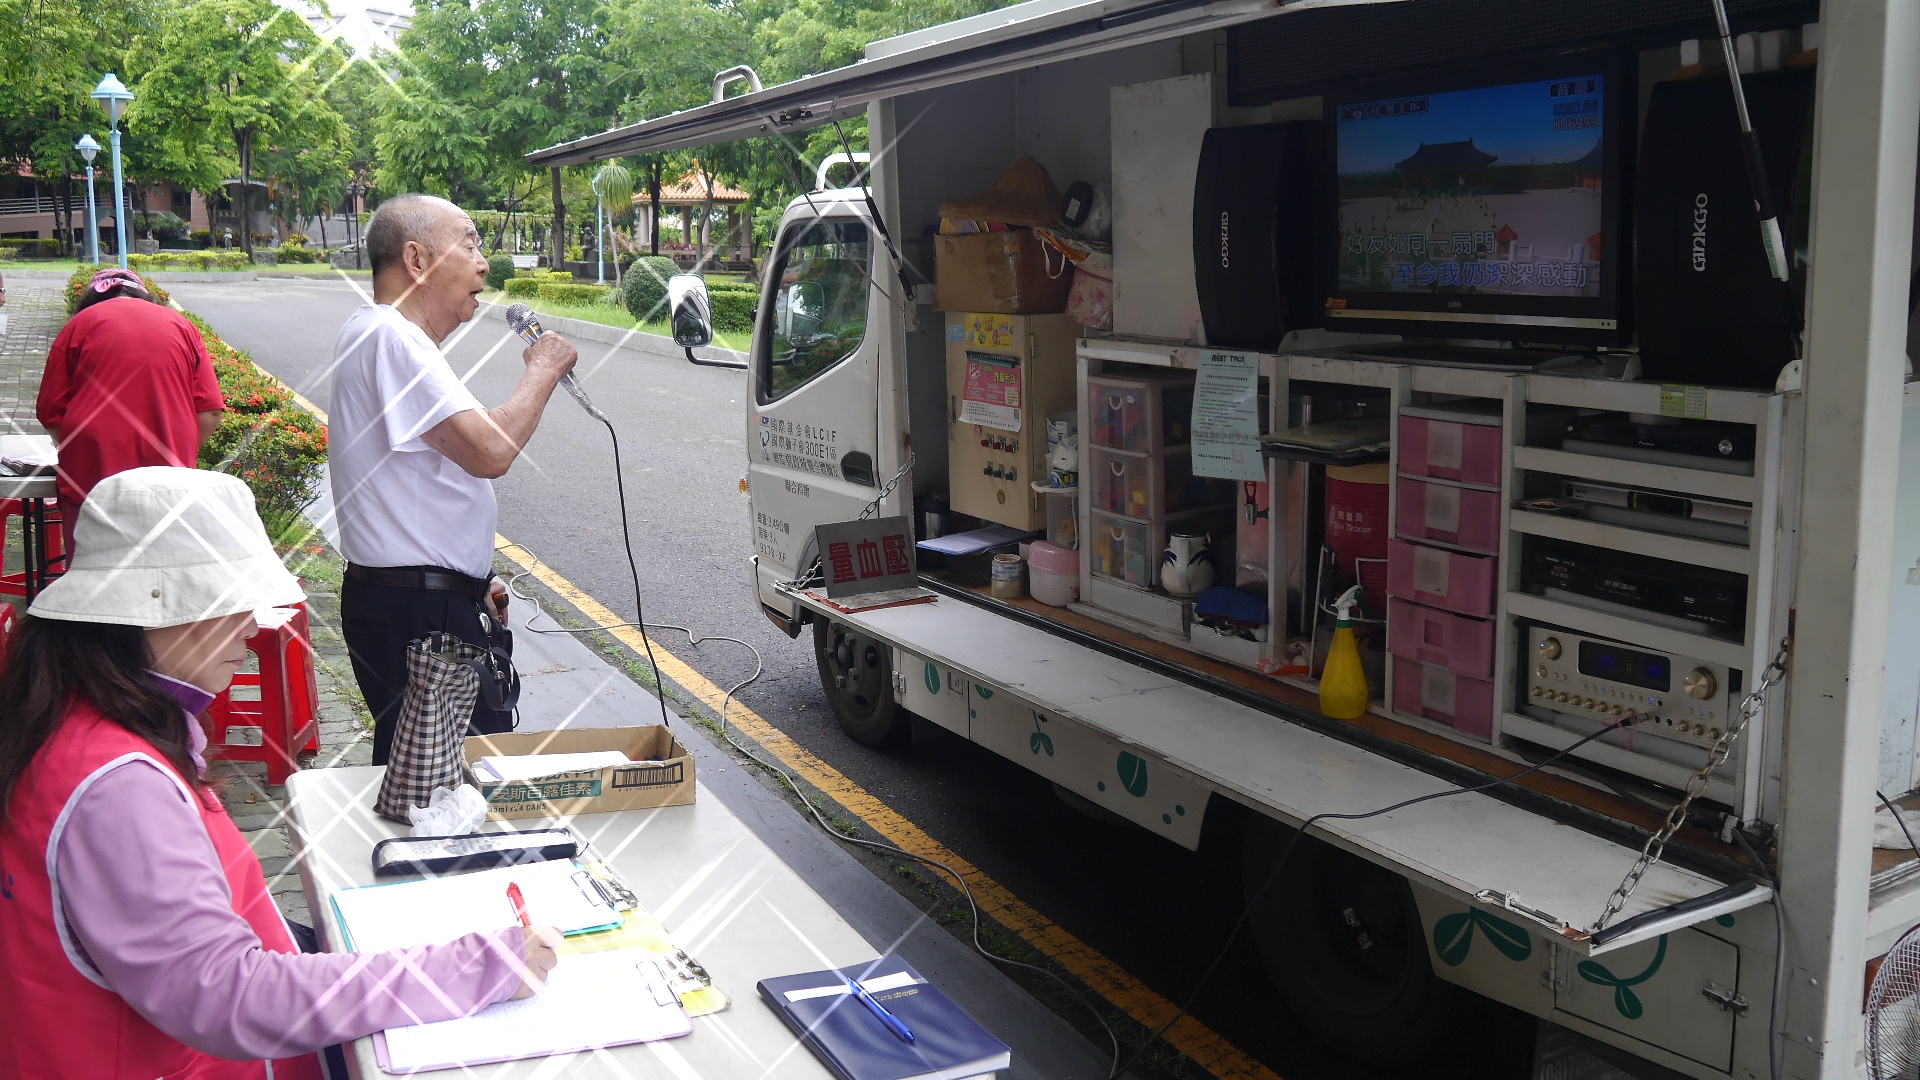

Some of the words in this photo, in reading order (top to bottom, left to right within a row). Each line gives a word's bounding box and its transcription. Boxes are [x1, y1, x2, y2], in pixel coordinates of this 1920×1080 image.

[1394, 263, 1587, 288] 至今我仍深深感動
[828, 533, 911, 584] 量血壓
[493, 782, 592, 802] 安斯百露佳素
[526, 802, 547, 811] CANS
